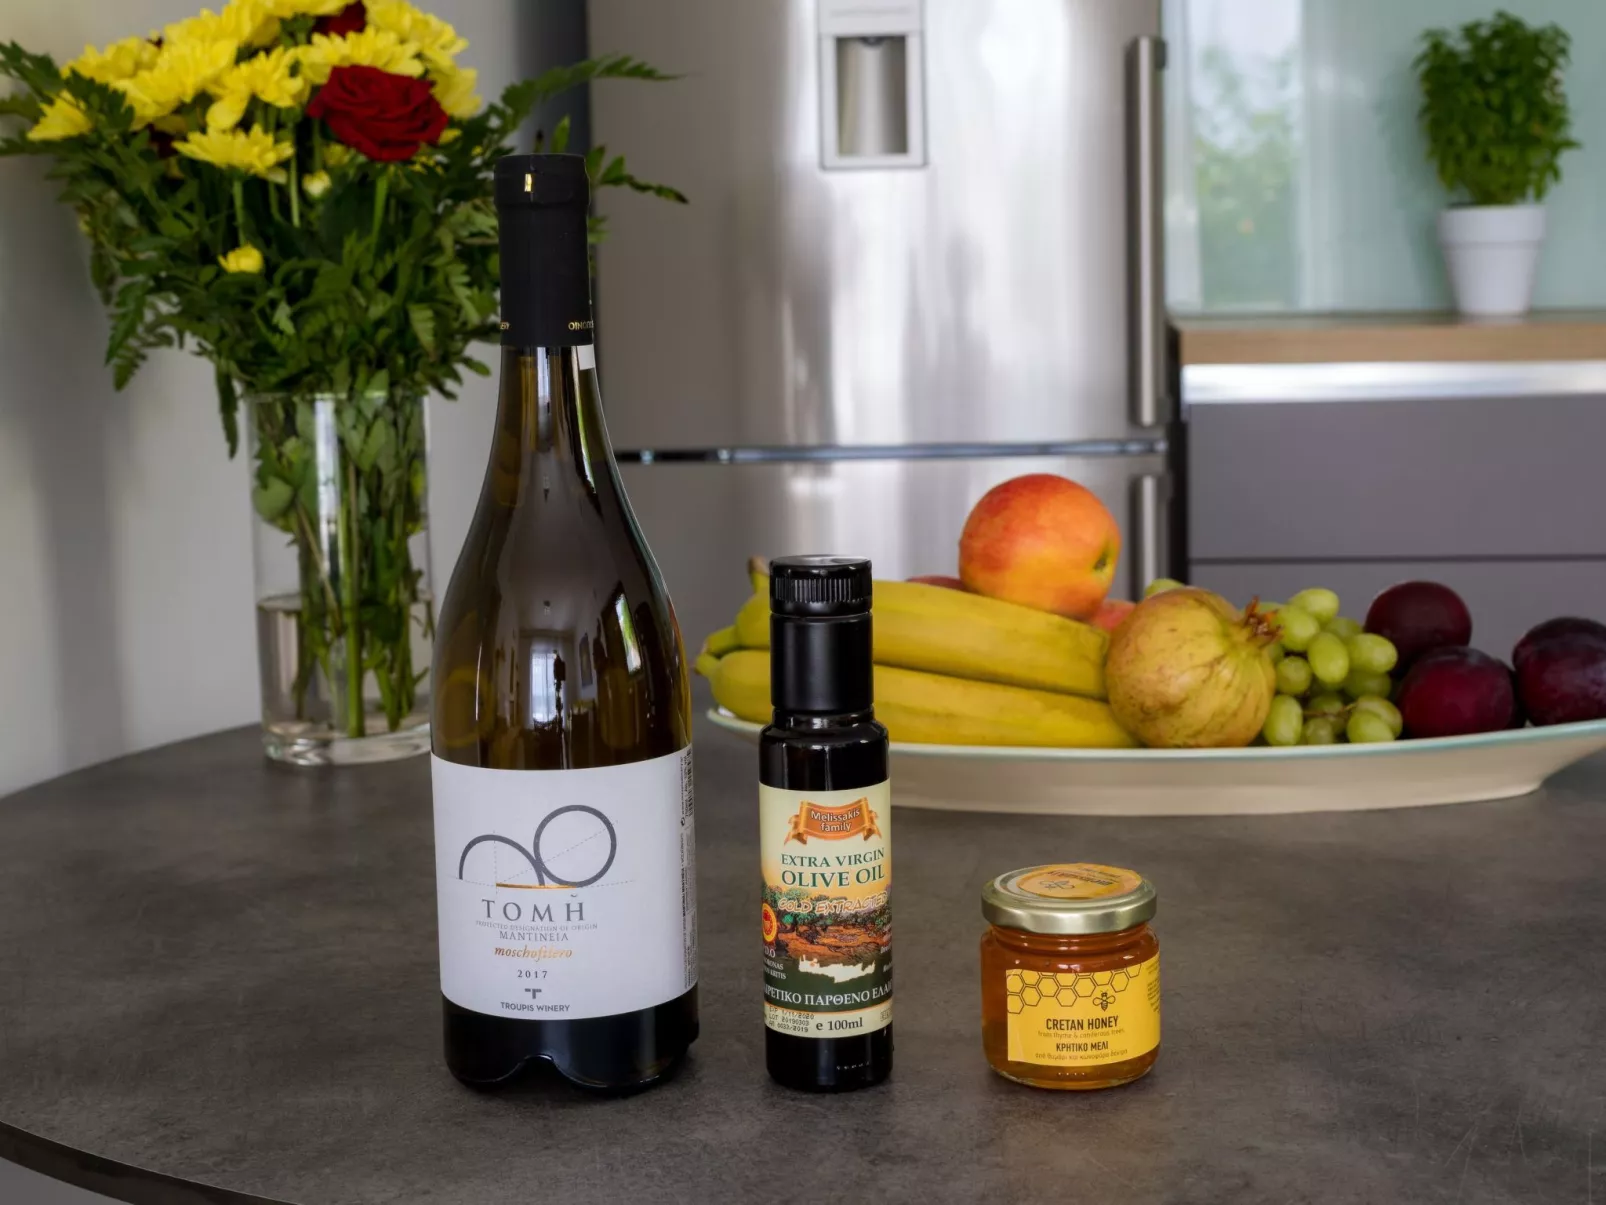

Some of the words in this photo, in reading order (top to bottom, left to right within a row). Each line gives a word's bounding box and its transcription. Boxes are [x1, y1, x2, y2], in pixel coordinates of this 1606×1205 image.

[811, 807, 861, 822] Melissakis
[820, 821, 852, 832] family
[781, 853, 831, 868] EXTRA
[835, 847, 885, 867] VIRGIN
[781, 870, 850, 888] OLIVE
[856, 864, 885, 884] OIL
[778, 897, 812, 912] COLD
[816, 891, 888, 915] EXTRACTED
[476, 920, 508, 929] PROTECTED
[510, 924, 558, 932] DESIGNATION
[571, 923, 598, 931] ORIGIN
[499, 930, 569, 941] MANTINEIA
[494, 945, 573, 962] moschofilero
[517, 969, 548, 979] 2017
[804, 991, 870, 1006] ΠΑΡΘΕΝΟ
[500, 1001, 534, 1012] TROUPIS
[536, 1004, 571, 1012] WINERY
[769, 1013, 779, 1021] LOT
[1046, 1018, 1084, 1031] CRETAN
[1087, 1015, 1119, 1030] HONEY
[828, 1017, 863, 1031] 100ml
[1053, 1031, 1072, 1040] thyme
[1079, 1030, 1110, 1038] coniferous
[1056, 1042, 1088, 1052] ΚΡΗΤΙΚΟ
[1090, 1041, 1109, 1051] ΜΕΛΙ
